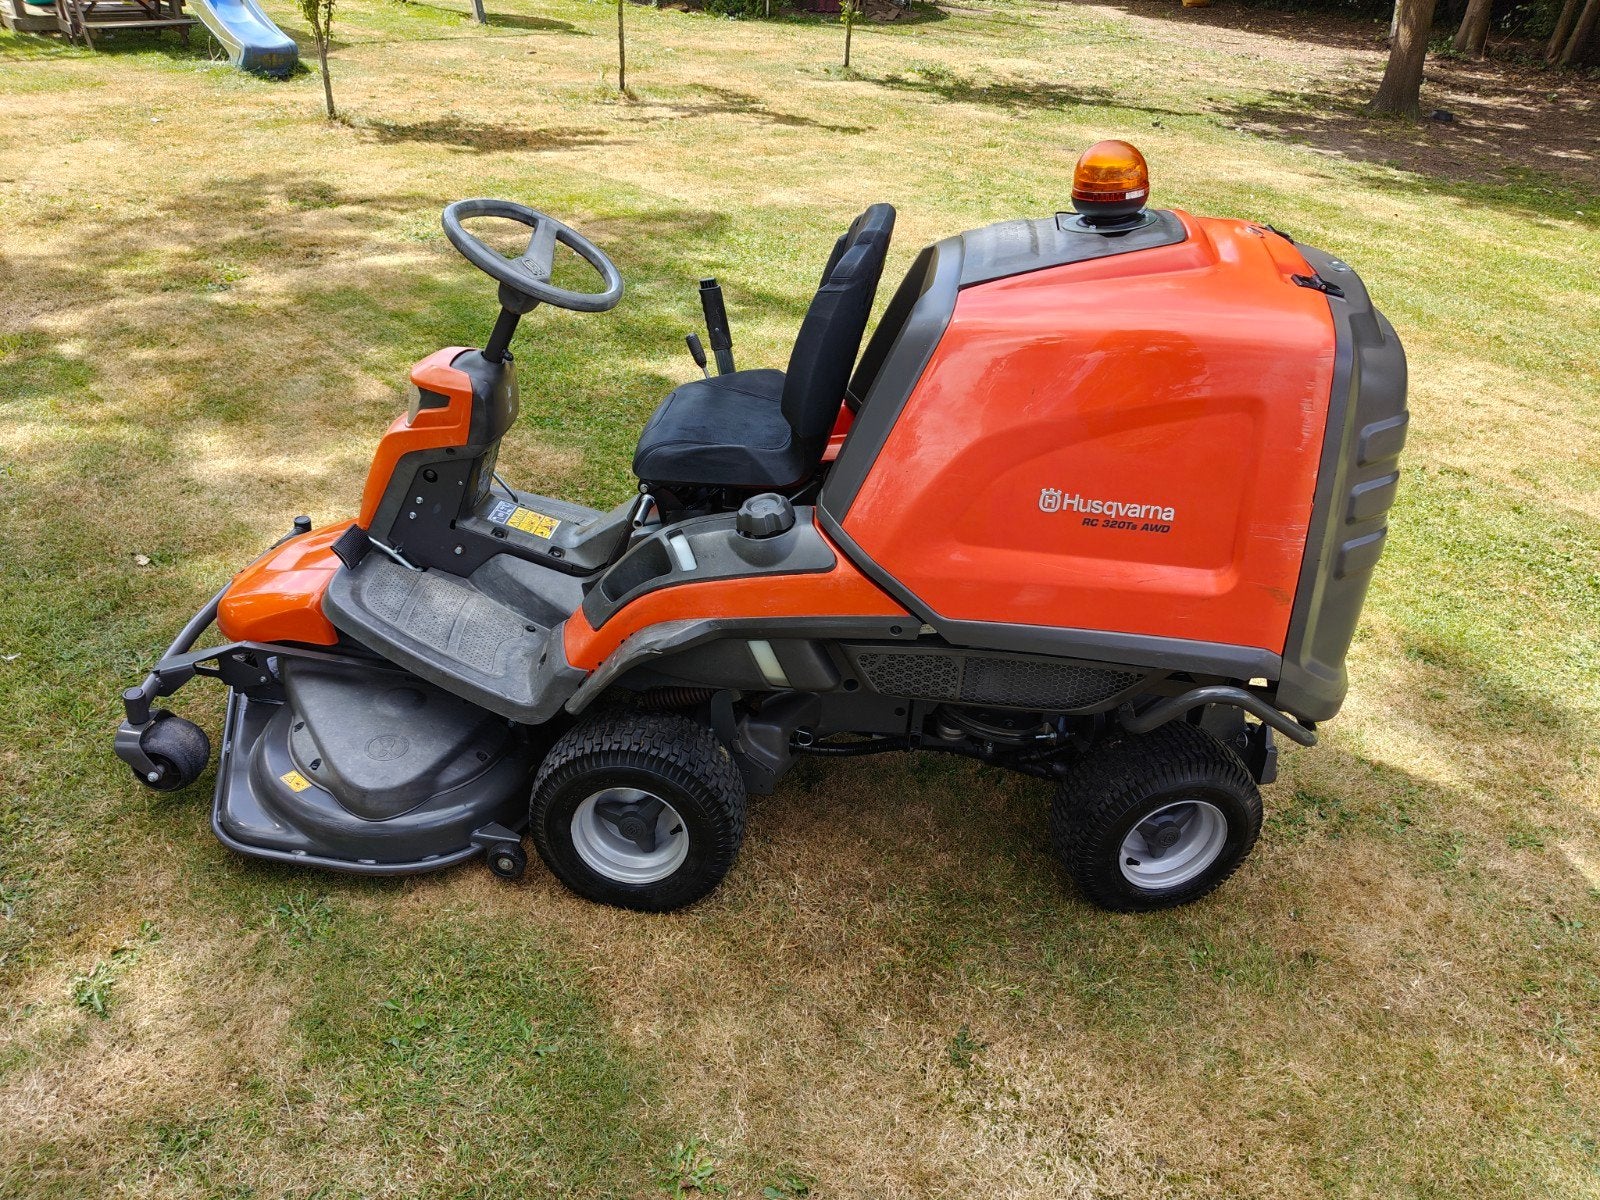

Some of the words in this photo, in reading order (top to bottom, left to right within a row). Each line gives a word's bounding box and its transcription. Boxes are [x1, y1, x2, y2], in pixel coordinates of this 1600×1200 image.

[1062, 493, 1175, 521] Husqvarna
[1082, 517, 1099, 527] RC
[1140, 523, 1171, 534] AWD
